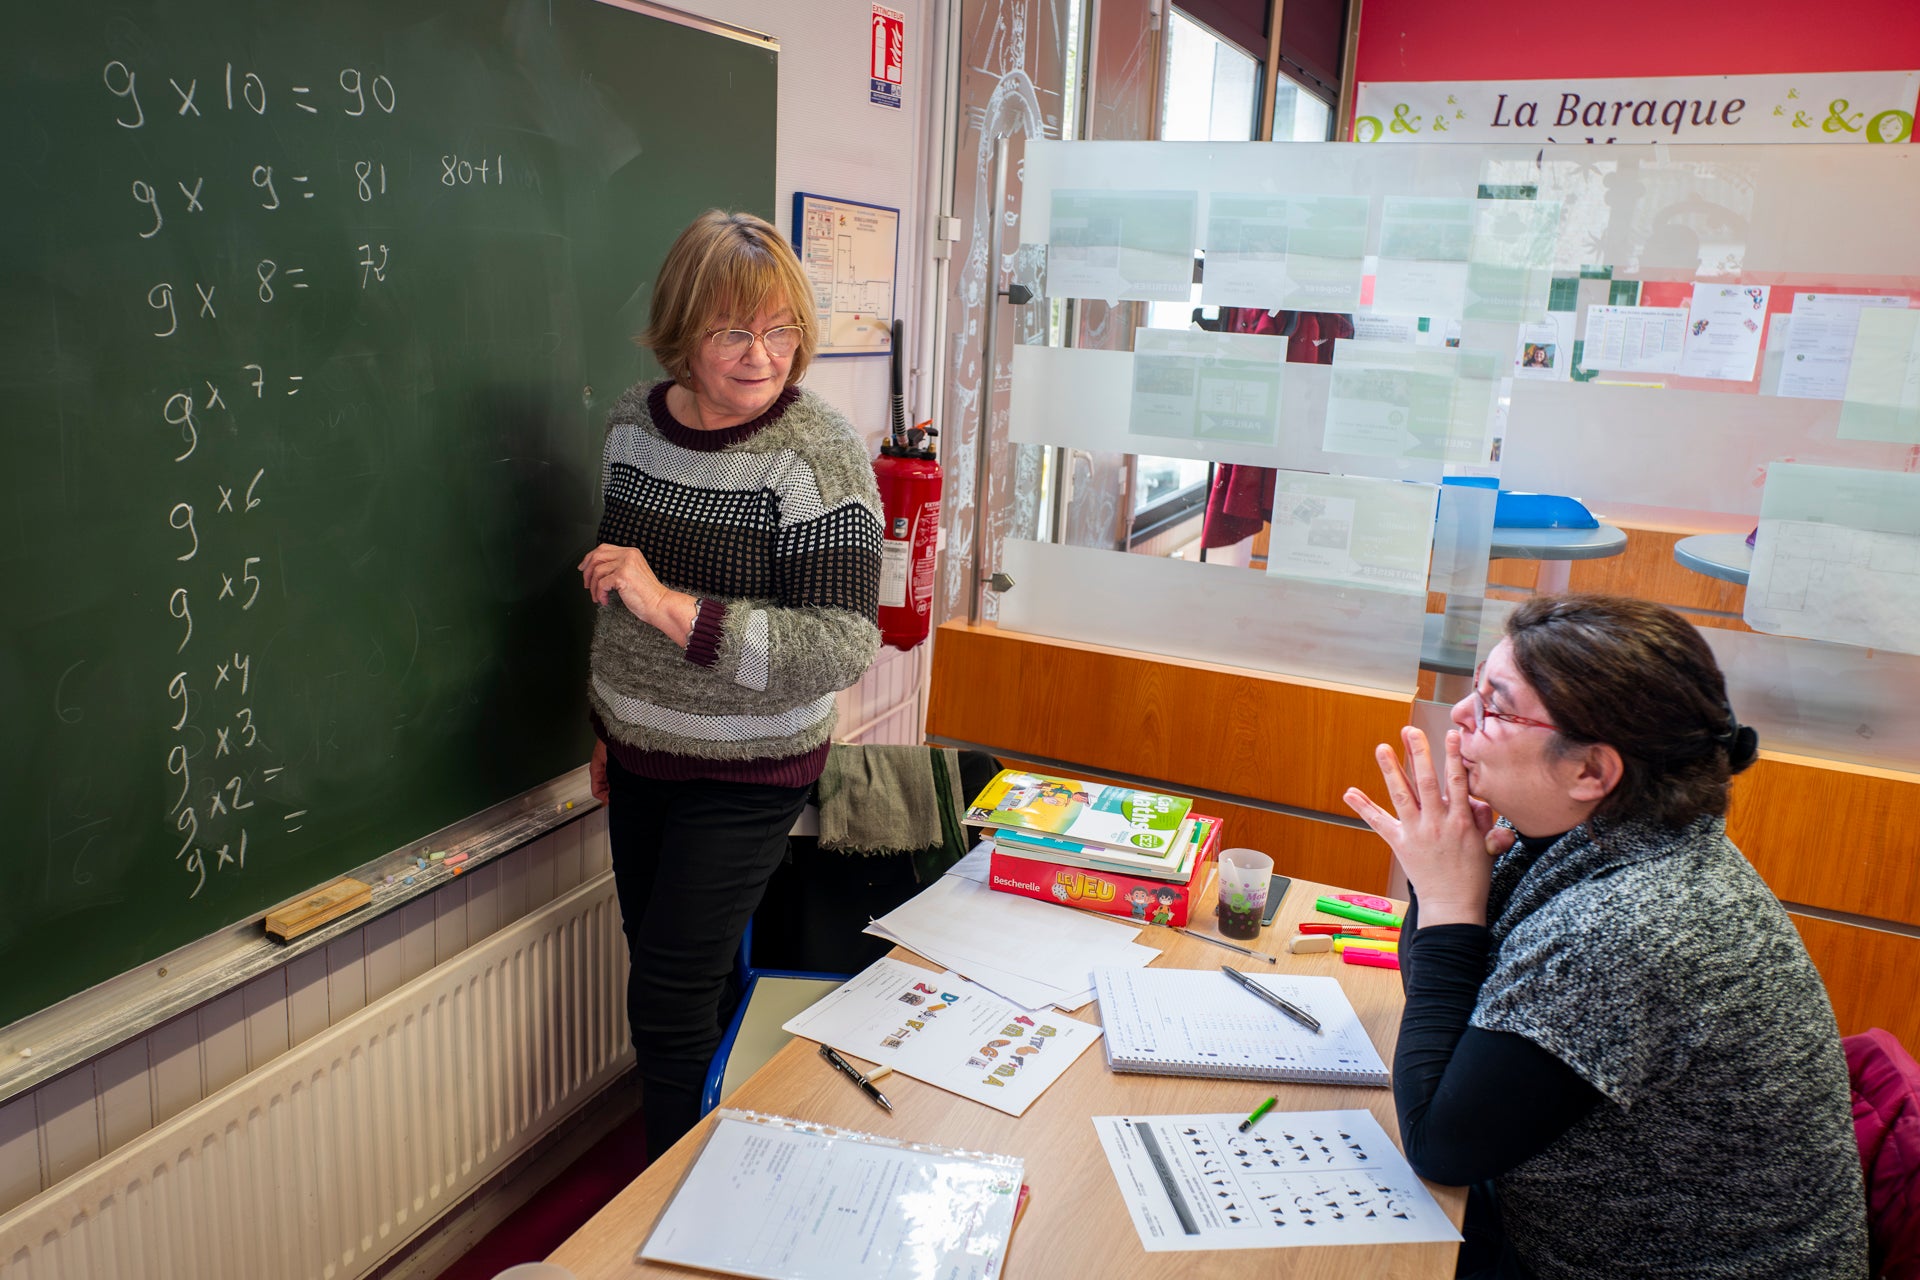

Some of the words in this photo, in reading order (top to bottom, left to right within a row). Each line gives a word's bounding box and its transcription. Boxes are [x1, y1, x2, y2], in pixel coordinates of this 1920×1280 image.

[873, 4, 904, 21] EXTINCTEUR
[225, 62, 266, 115] 10
[339, 68, 396, 116] 90
[1490, 94, 1539, 128] La
[1553, 92, 1746, 135] Baraque
[354, 161, 386, 202] 81
[243, 364, 264, 398] 7
[1131, 791, 1157, 830] Maths
[1155, 796, 1174, 813] Cap
[994, 875, 1040, 893] Bescherelle
[1056, 871, 1073, 886] LE
[1066, 872, 1116, 903] JEU
